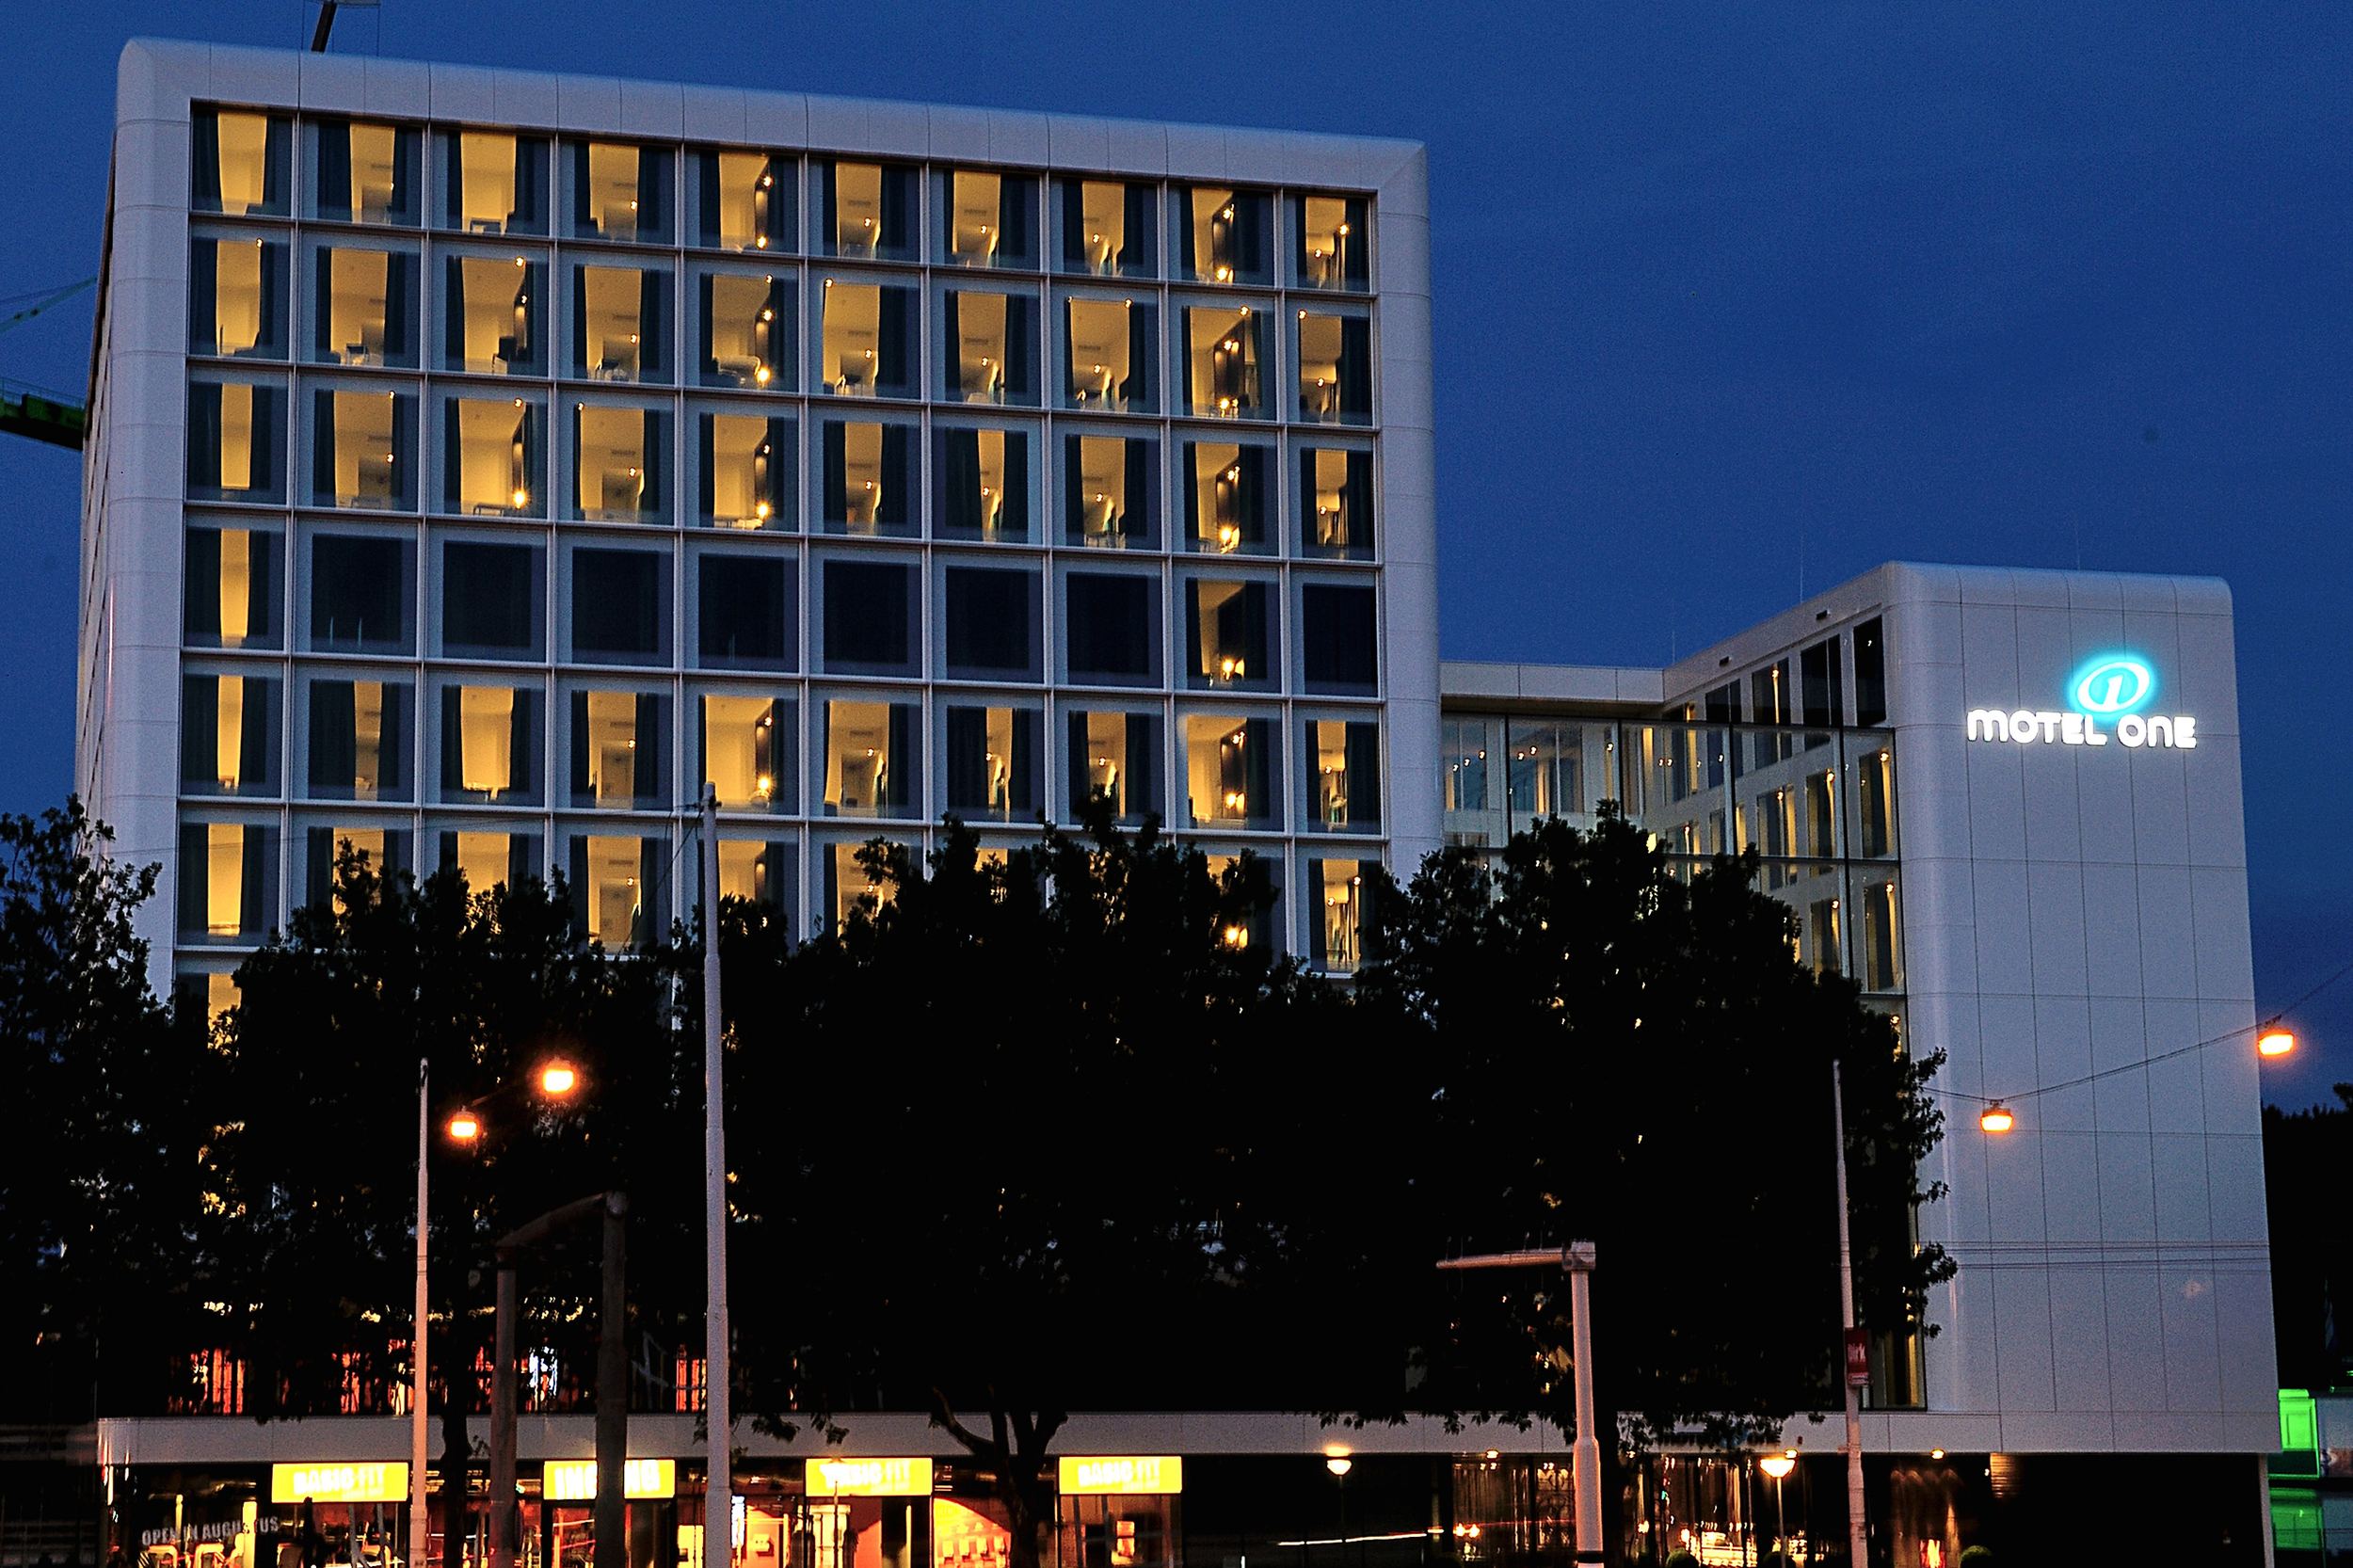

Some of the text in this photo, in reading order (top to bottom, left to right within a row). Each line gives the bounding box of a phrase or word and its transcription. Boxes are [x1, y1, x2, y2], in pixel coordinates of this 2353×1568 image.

[1967, 709, 2198, 749] MOTEL ONE
[554, 1460, 661, 1500] INGNG
